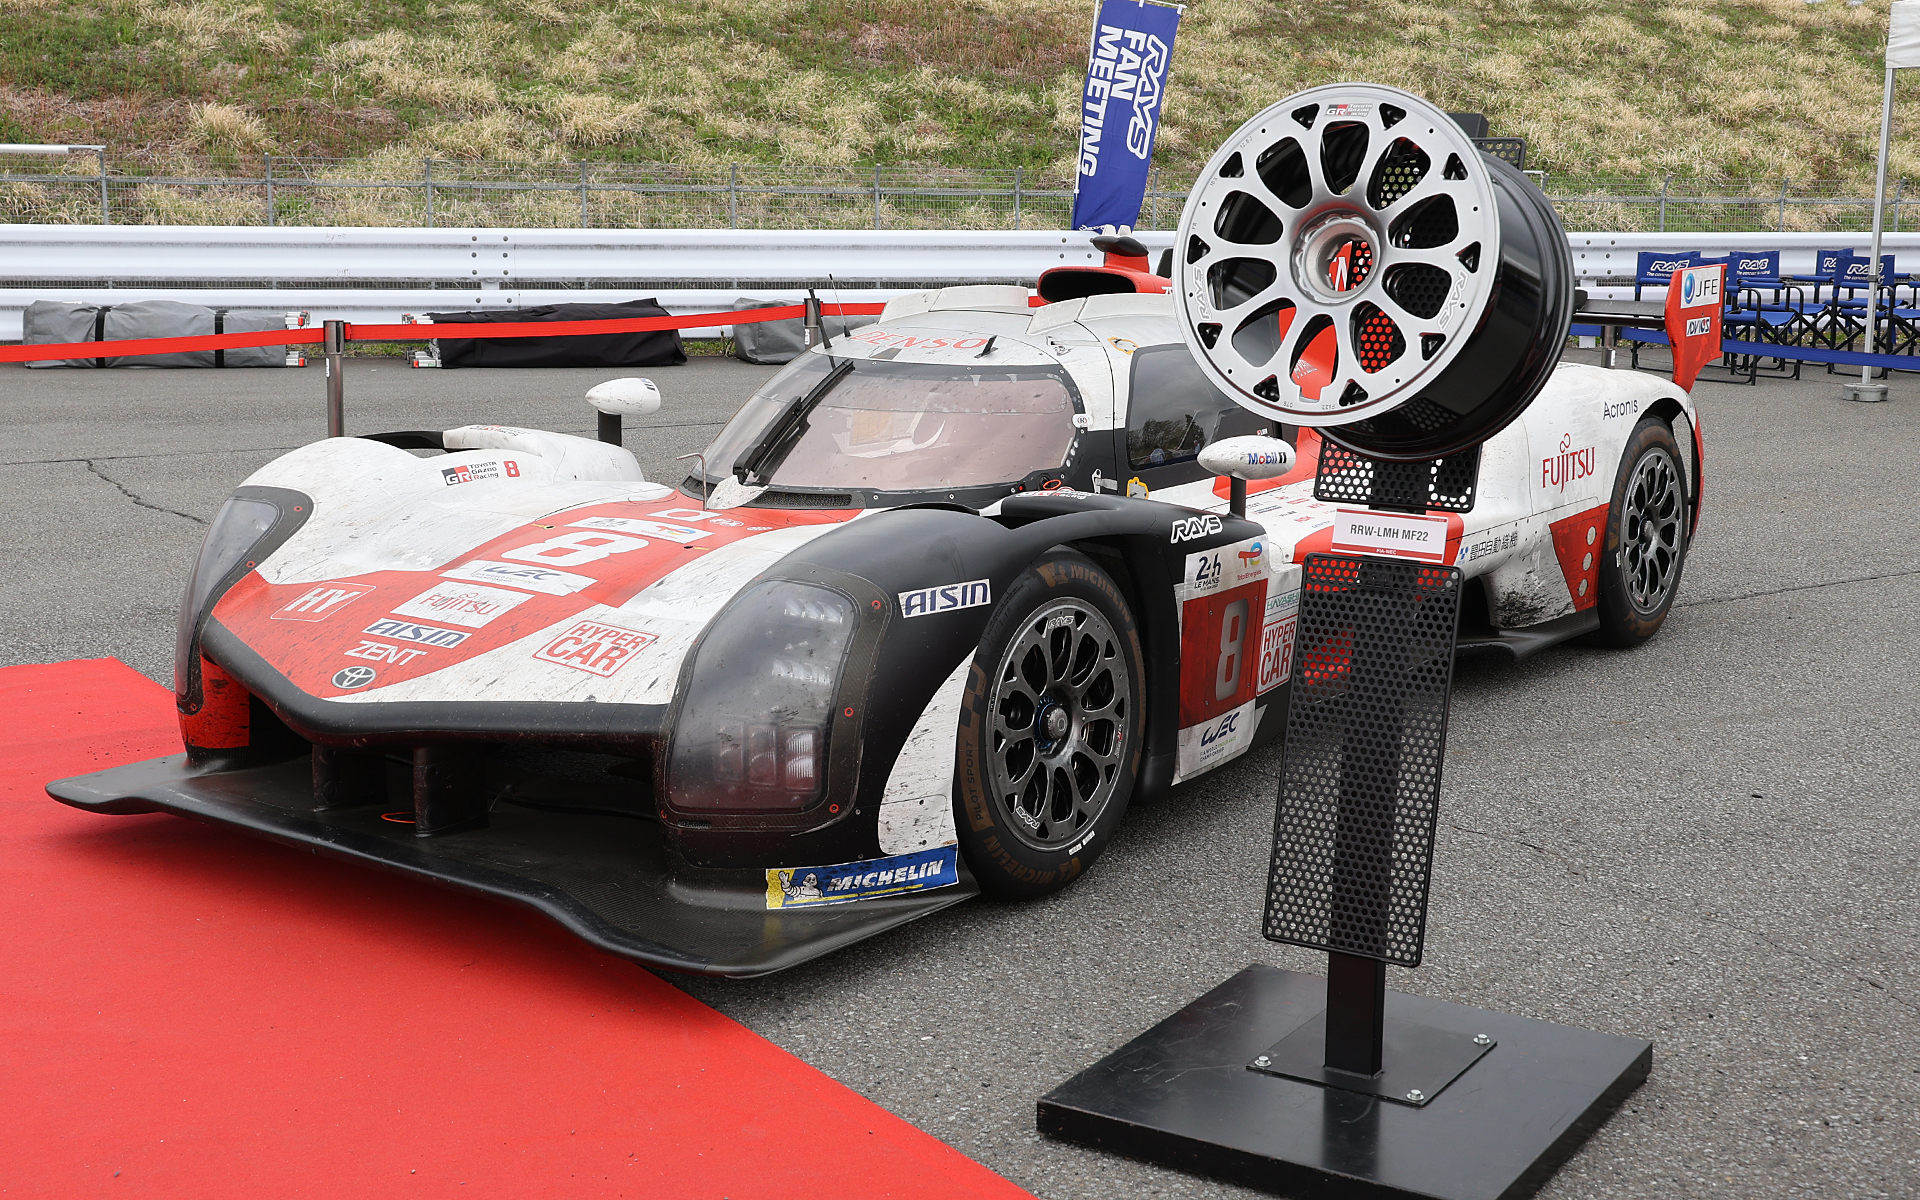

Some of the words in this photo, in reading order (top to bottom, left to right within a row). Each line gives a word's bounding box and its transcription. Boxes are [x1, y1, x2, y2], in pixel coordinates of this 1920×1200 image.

[1110, 29, 1148, 100] FAN
[1081, 24, 1124, 177] MEETING
[1126, 34, 1168, 160] RAYS
[1650, 259, 1690, 273] RAYS
[1738, 258, 1769, 271] RAYS
[1192, 265, 1212, 320] RAYS
[1437, 269, 1468, 332] RAYS
[1695, 278, 1719, 297] JFE
[849, 330, 989, 349] DENSO
[1603, 399, 1639, 420] Acronis
[503, 460, 520, 478] 8
[1248, 452, 1278, 465] Mobil
[1542, 446, 1595, 494] FUJITSU
[445, 470, 473, 485] GR
[473, 472, 499, 481] Racing
[1170, 515, 1223, 544] RAYS
[1350, 524, 1400, 539] RRW-LMH
[1401, 530, 1429, 542] MF22
[500, 531, 650, 567] 8
[484, 566, 562, 580] WEC
[1195, 552, 1222, 581] 24h
[1071, 564, 1131, 623] MICHELIN
[1194, 581, 1202, 589] LE
[1202, 577, 1220, 588] MANS
[284, 587, 362, 614] HY
[419, 594, 501, 616] FUJITSU
[903, 582, 989, 616] AISIN
[366, 621, 466, 646] AISIN
[570, 624, 647, 650] HYPER
[1047, 615, 1074, 630] RAYS
[1264, 620, 1296, 652] HYPER
[343, 640, 428, 666] ZENT
[546, 636, 629, 672] CAR
[1215, 598, 1250, 702] 8
[1260, 643, 1292, 686] CAR
[1200, 711, 1241, 747] WEC
[965, 740, 975, 784] SPORT
[968, 787, 984, 821] PILOT
[826, 859, 944, 893] MICHELIN
